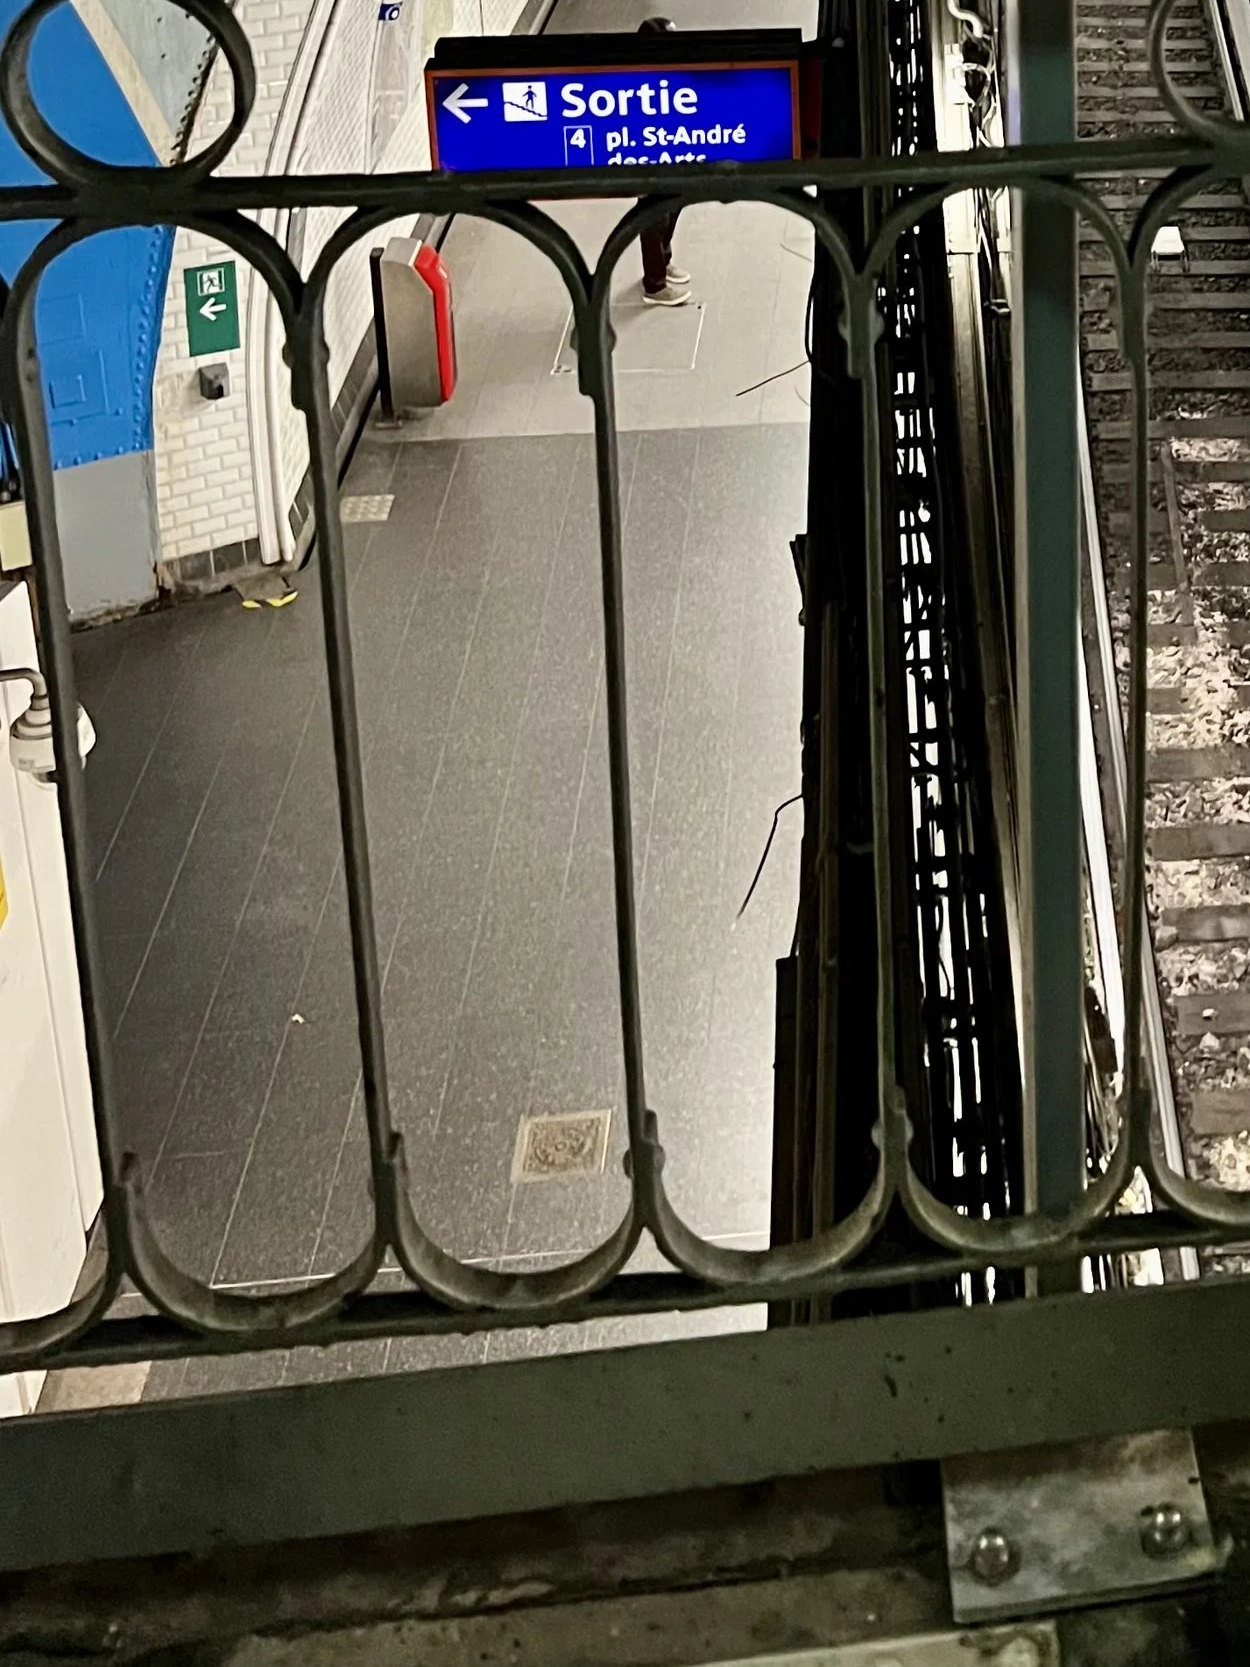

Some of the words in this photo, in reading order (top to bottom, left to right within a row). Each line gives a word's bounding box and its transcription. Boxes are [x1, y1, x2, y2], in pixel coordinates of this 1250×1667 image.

[561, 79, 698, 118] Sortie
[570, 128, 587, 148] 4
[606, 126, 637, 152] pl.
[642, 123, 747, 146] St-André
